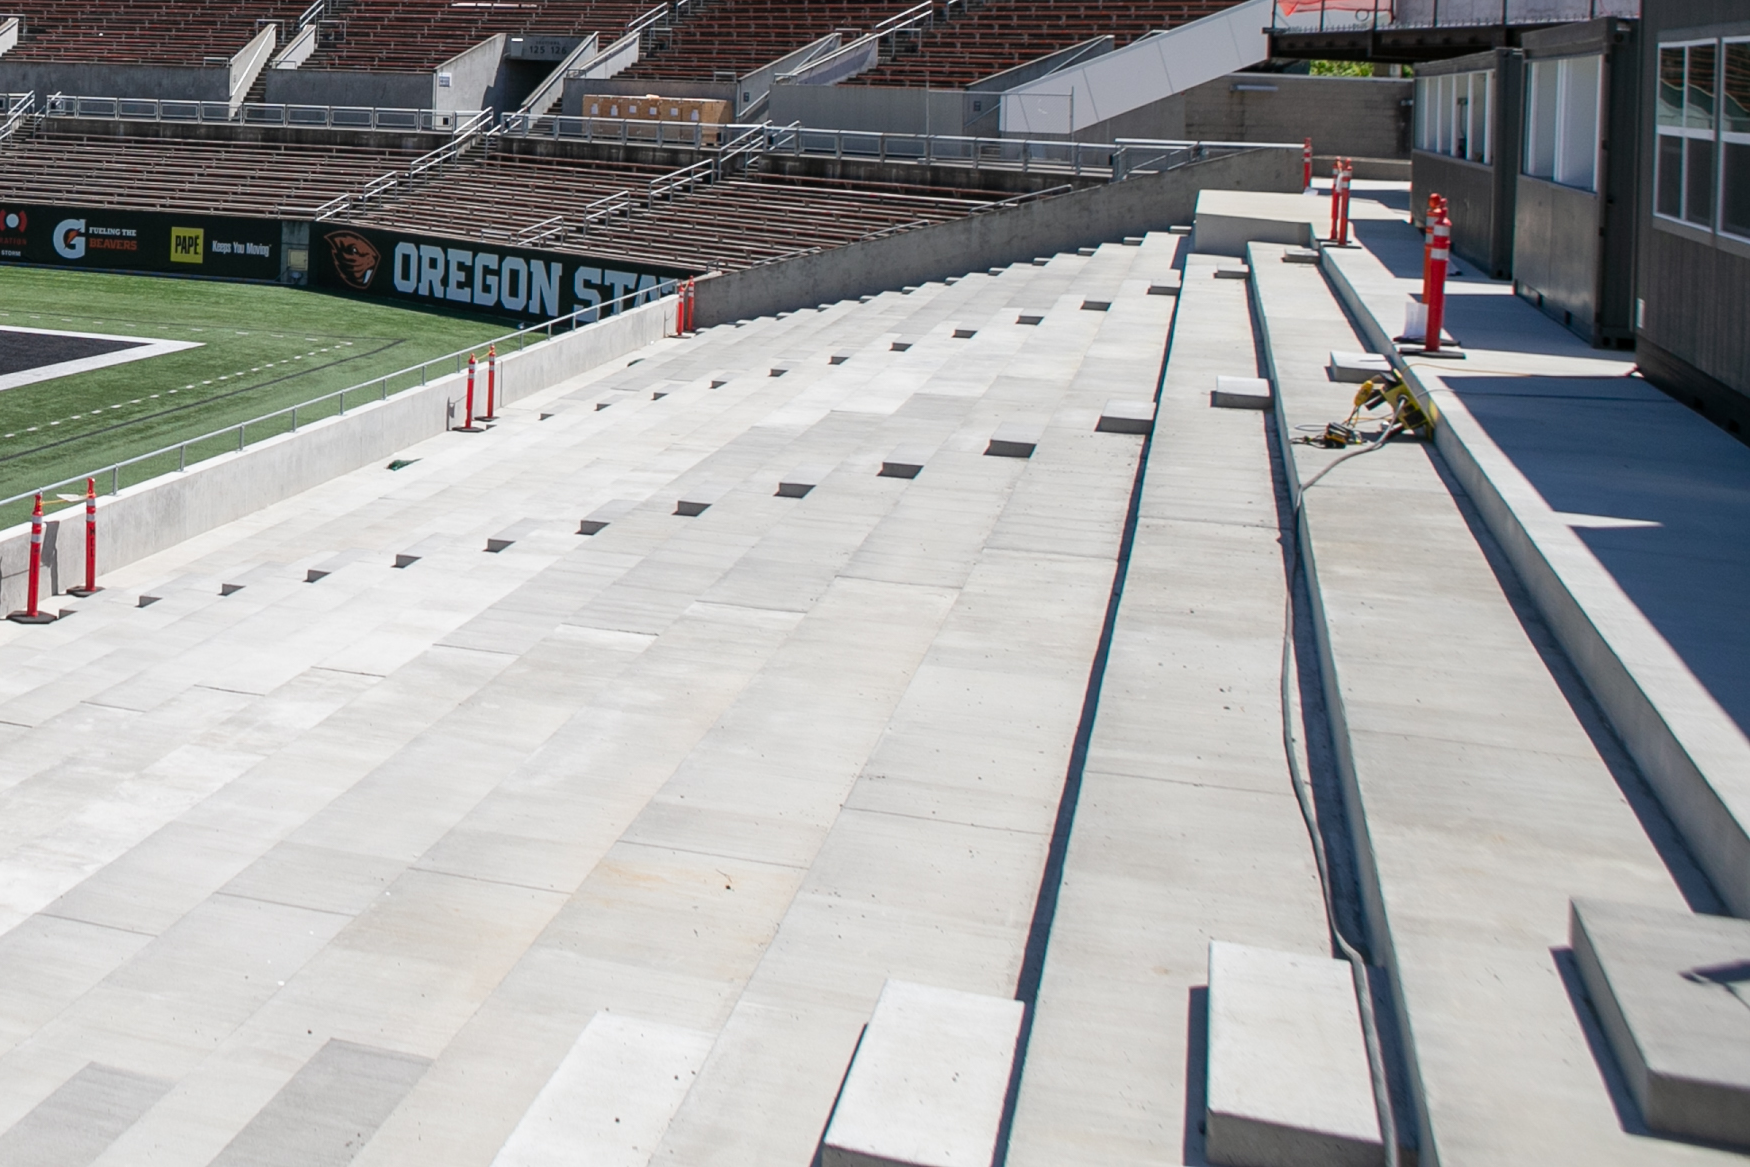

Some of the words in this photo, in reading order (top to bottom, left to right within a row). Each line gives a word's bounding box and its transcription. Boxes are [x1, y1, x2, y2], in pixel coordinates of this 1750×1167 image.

[529, 45, 546, 54] 125
[551, 46, 568, 55] 126
[88, 226, 121, 236] FUELING
[122, 228, 137, 237] THE
[53, 218, 86, 260] G
[88, 238, 137, 251] BEAVERS
[1, 249, 22, 257] STORM
[212, 240, 232, 254] Keeps
[233, 242, 245, 254] You
[246, 242, 271, 258] Moving
[393, 242, 563, 318] OREGON
